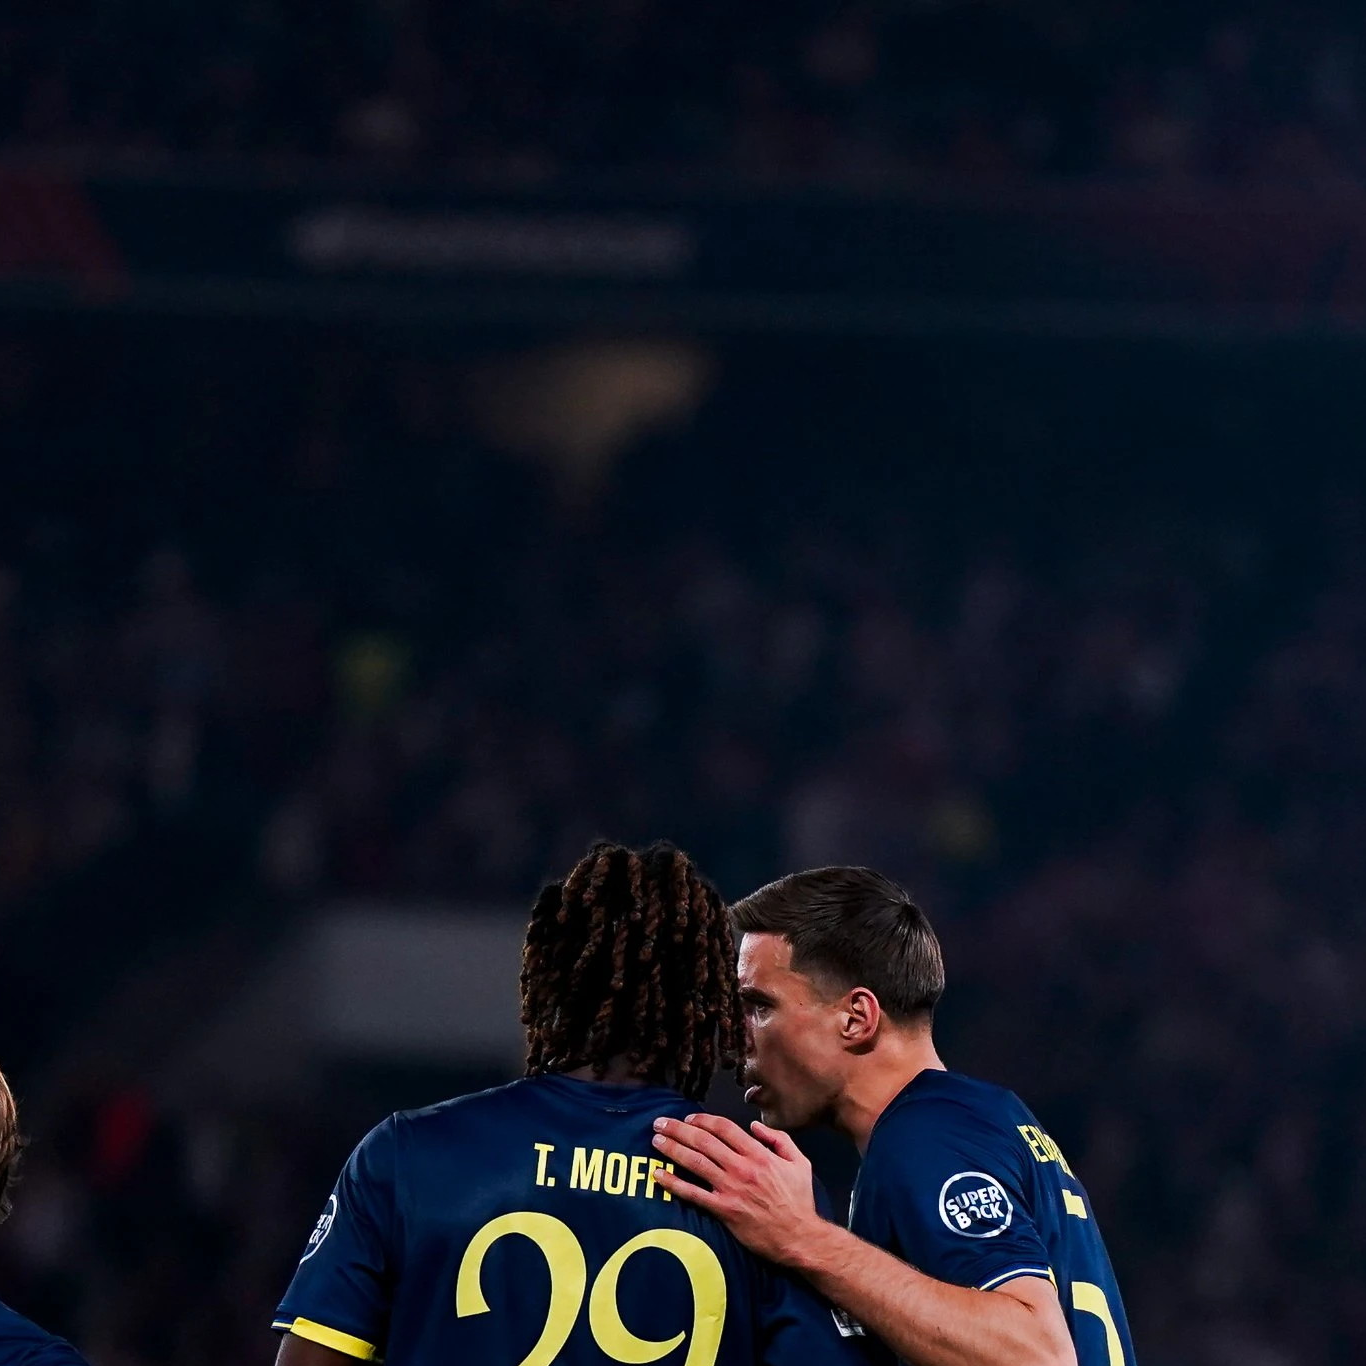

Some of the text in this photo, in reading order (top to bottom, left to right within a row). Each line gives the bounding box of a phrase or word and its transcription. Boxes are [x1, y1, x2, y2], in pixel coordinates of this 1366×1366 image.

[534, 1142, 556, 1187] T.
[946, 1186, 1003, 1216] SUPER
[955, 1202, 1005, 1230] BOCK
